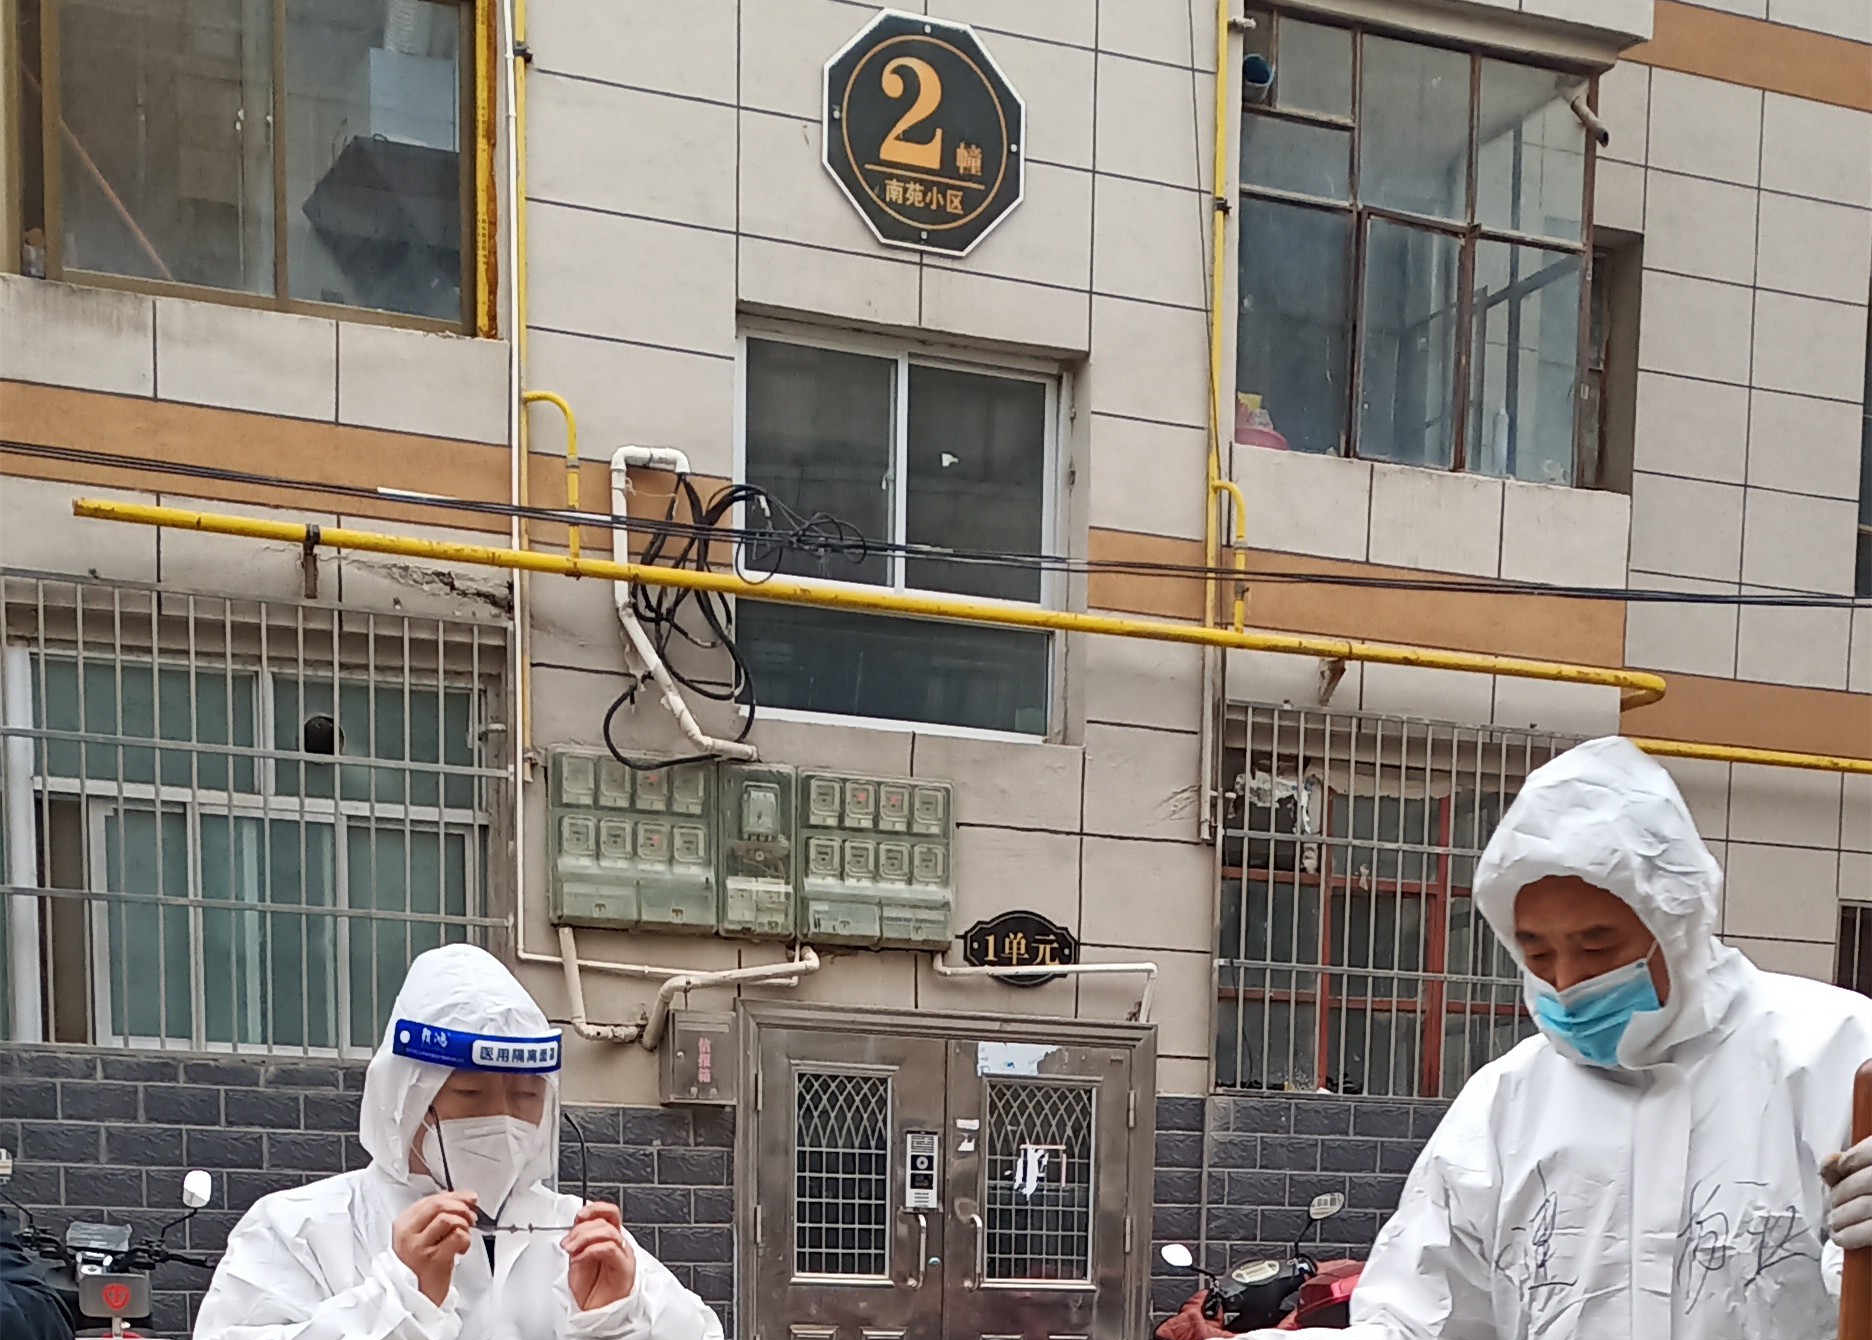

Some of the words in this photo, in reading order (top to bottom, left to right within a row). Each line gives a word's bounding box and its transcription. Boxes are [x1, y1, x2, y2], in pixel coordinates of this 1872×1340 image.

[885, 178, 964, 215] 南苑小区
[984, 932, 1060, 966] 1单元
